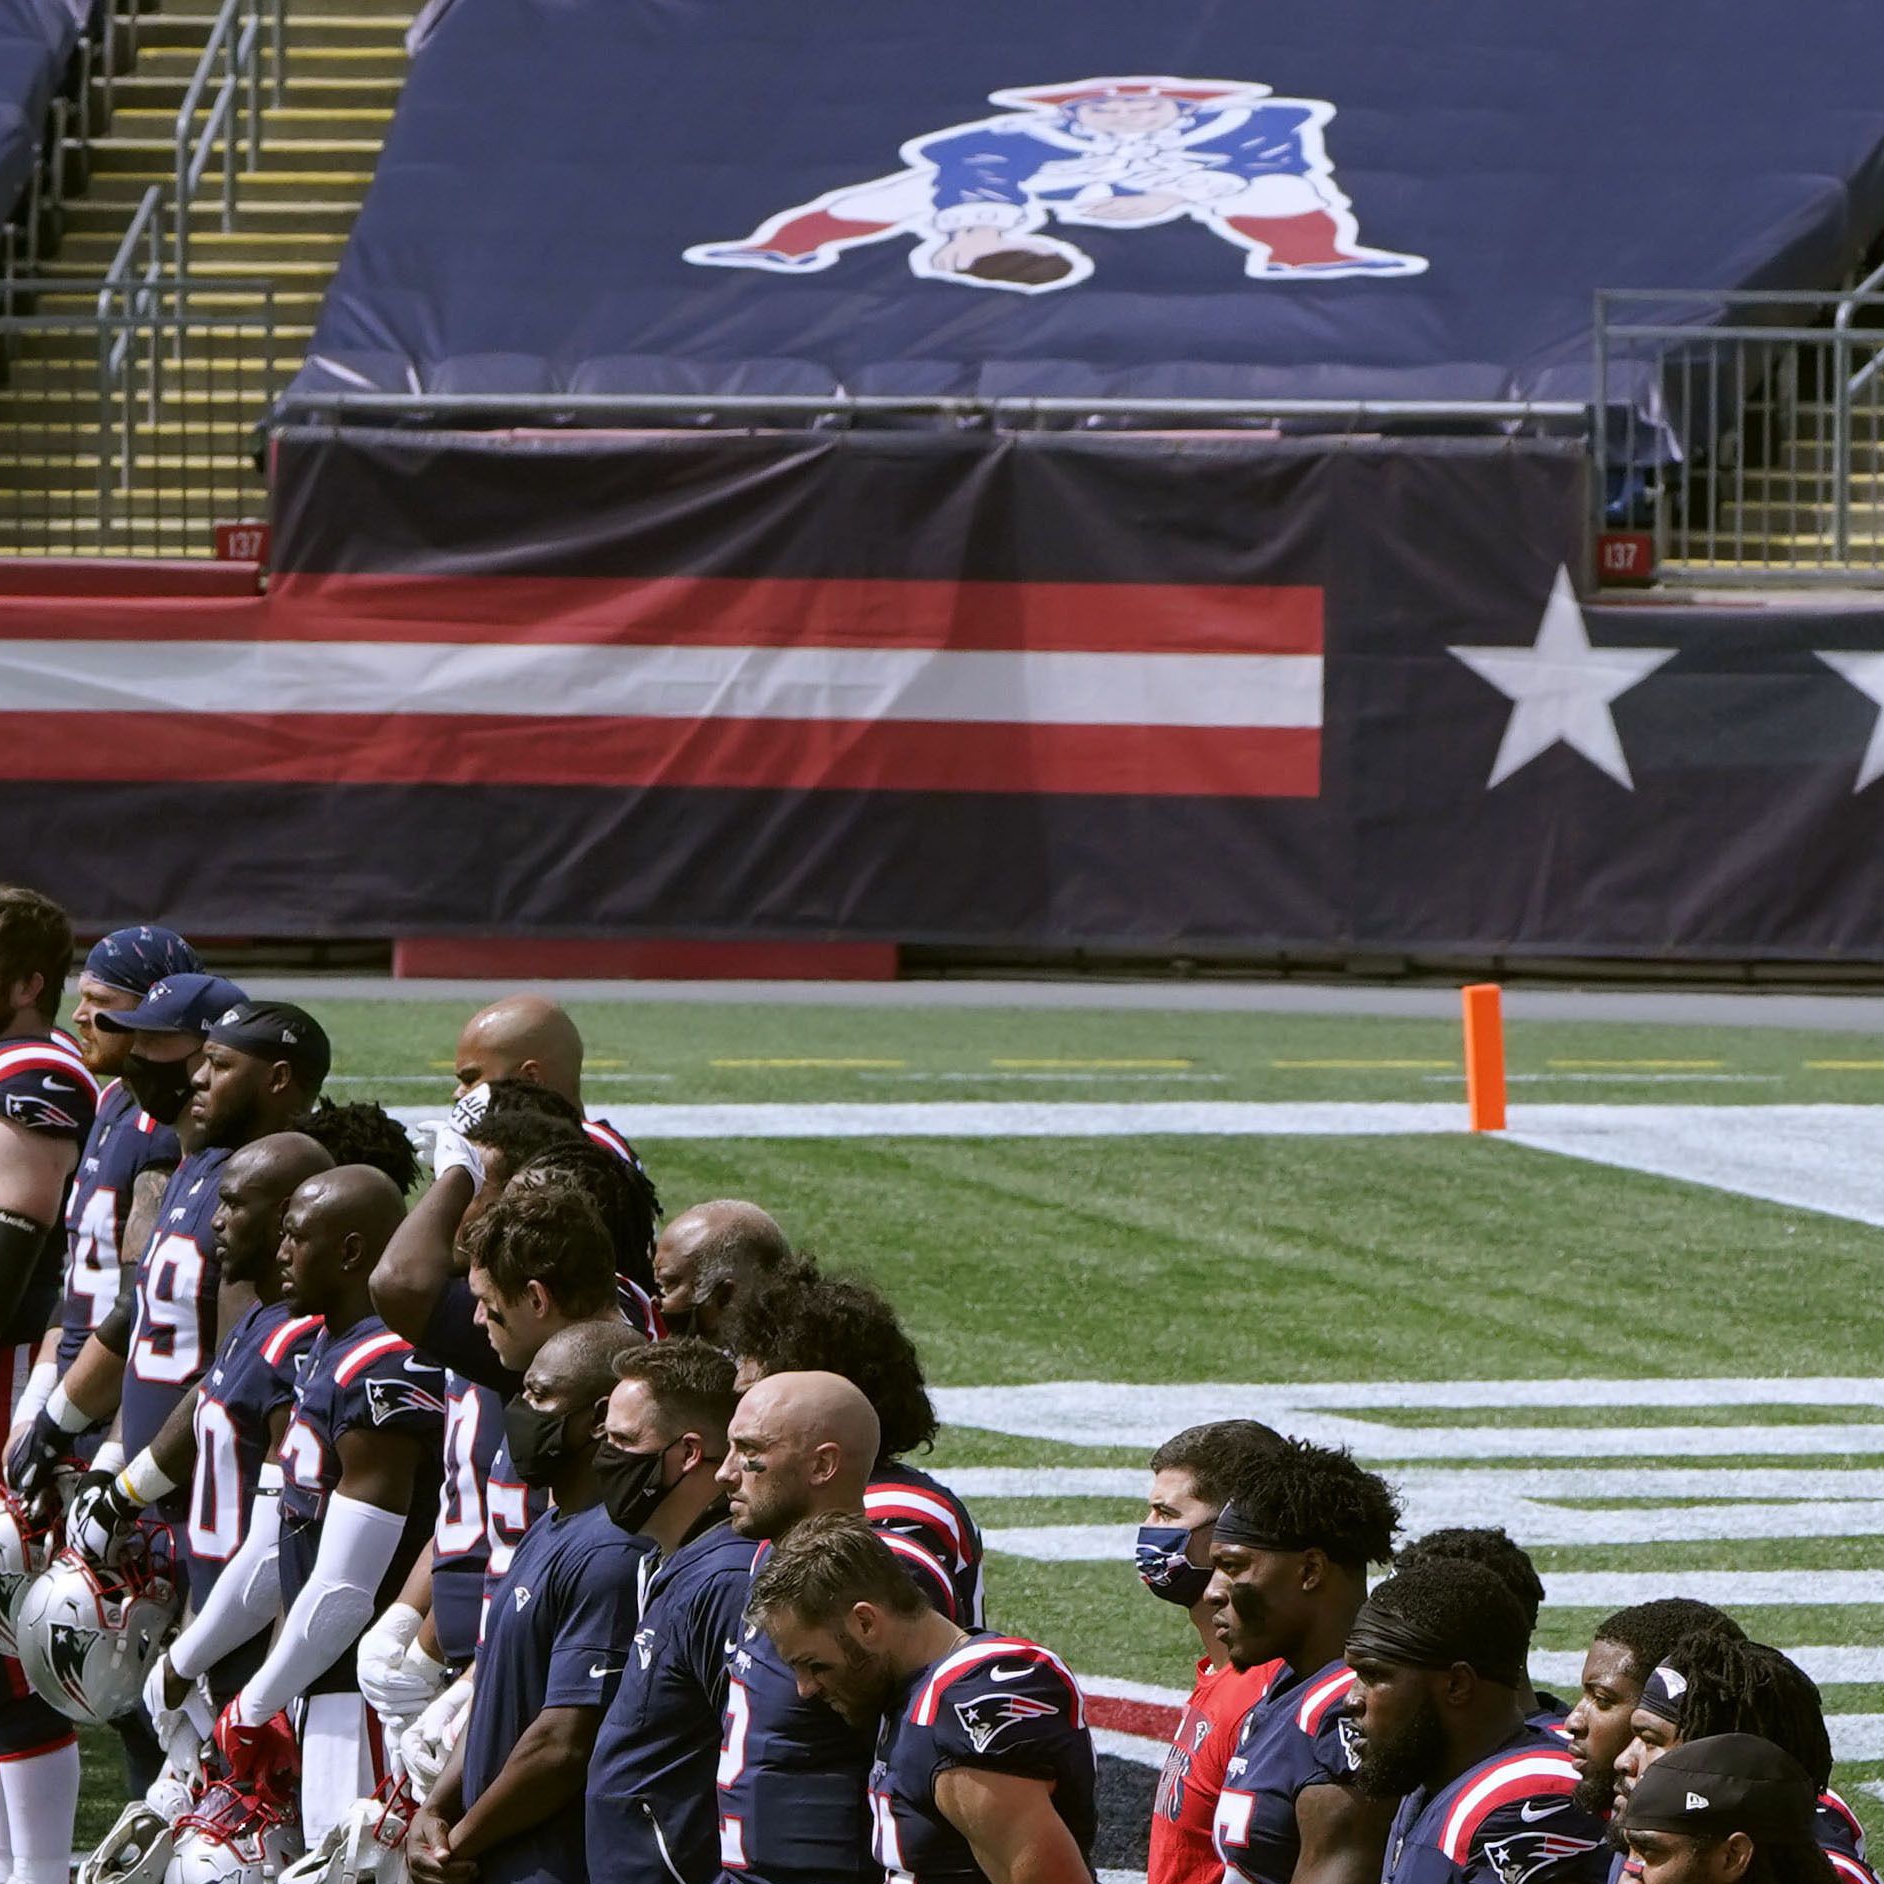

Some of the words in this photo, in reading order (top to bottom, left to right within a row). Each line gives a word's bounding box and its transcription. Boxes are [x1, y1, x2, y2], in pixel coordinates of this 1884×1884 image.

[1603, 543, 1638, 570] 137
[65, 1178, 121, 1330] 4
[130, 1231, 206, 1385] 9
